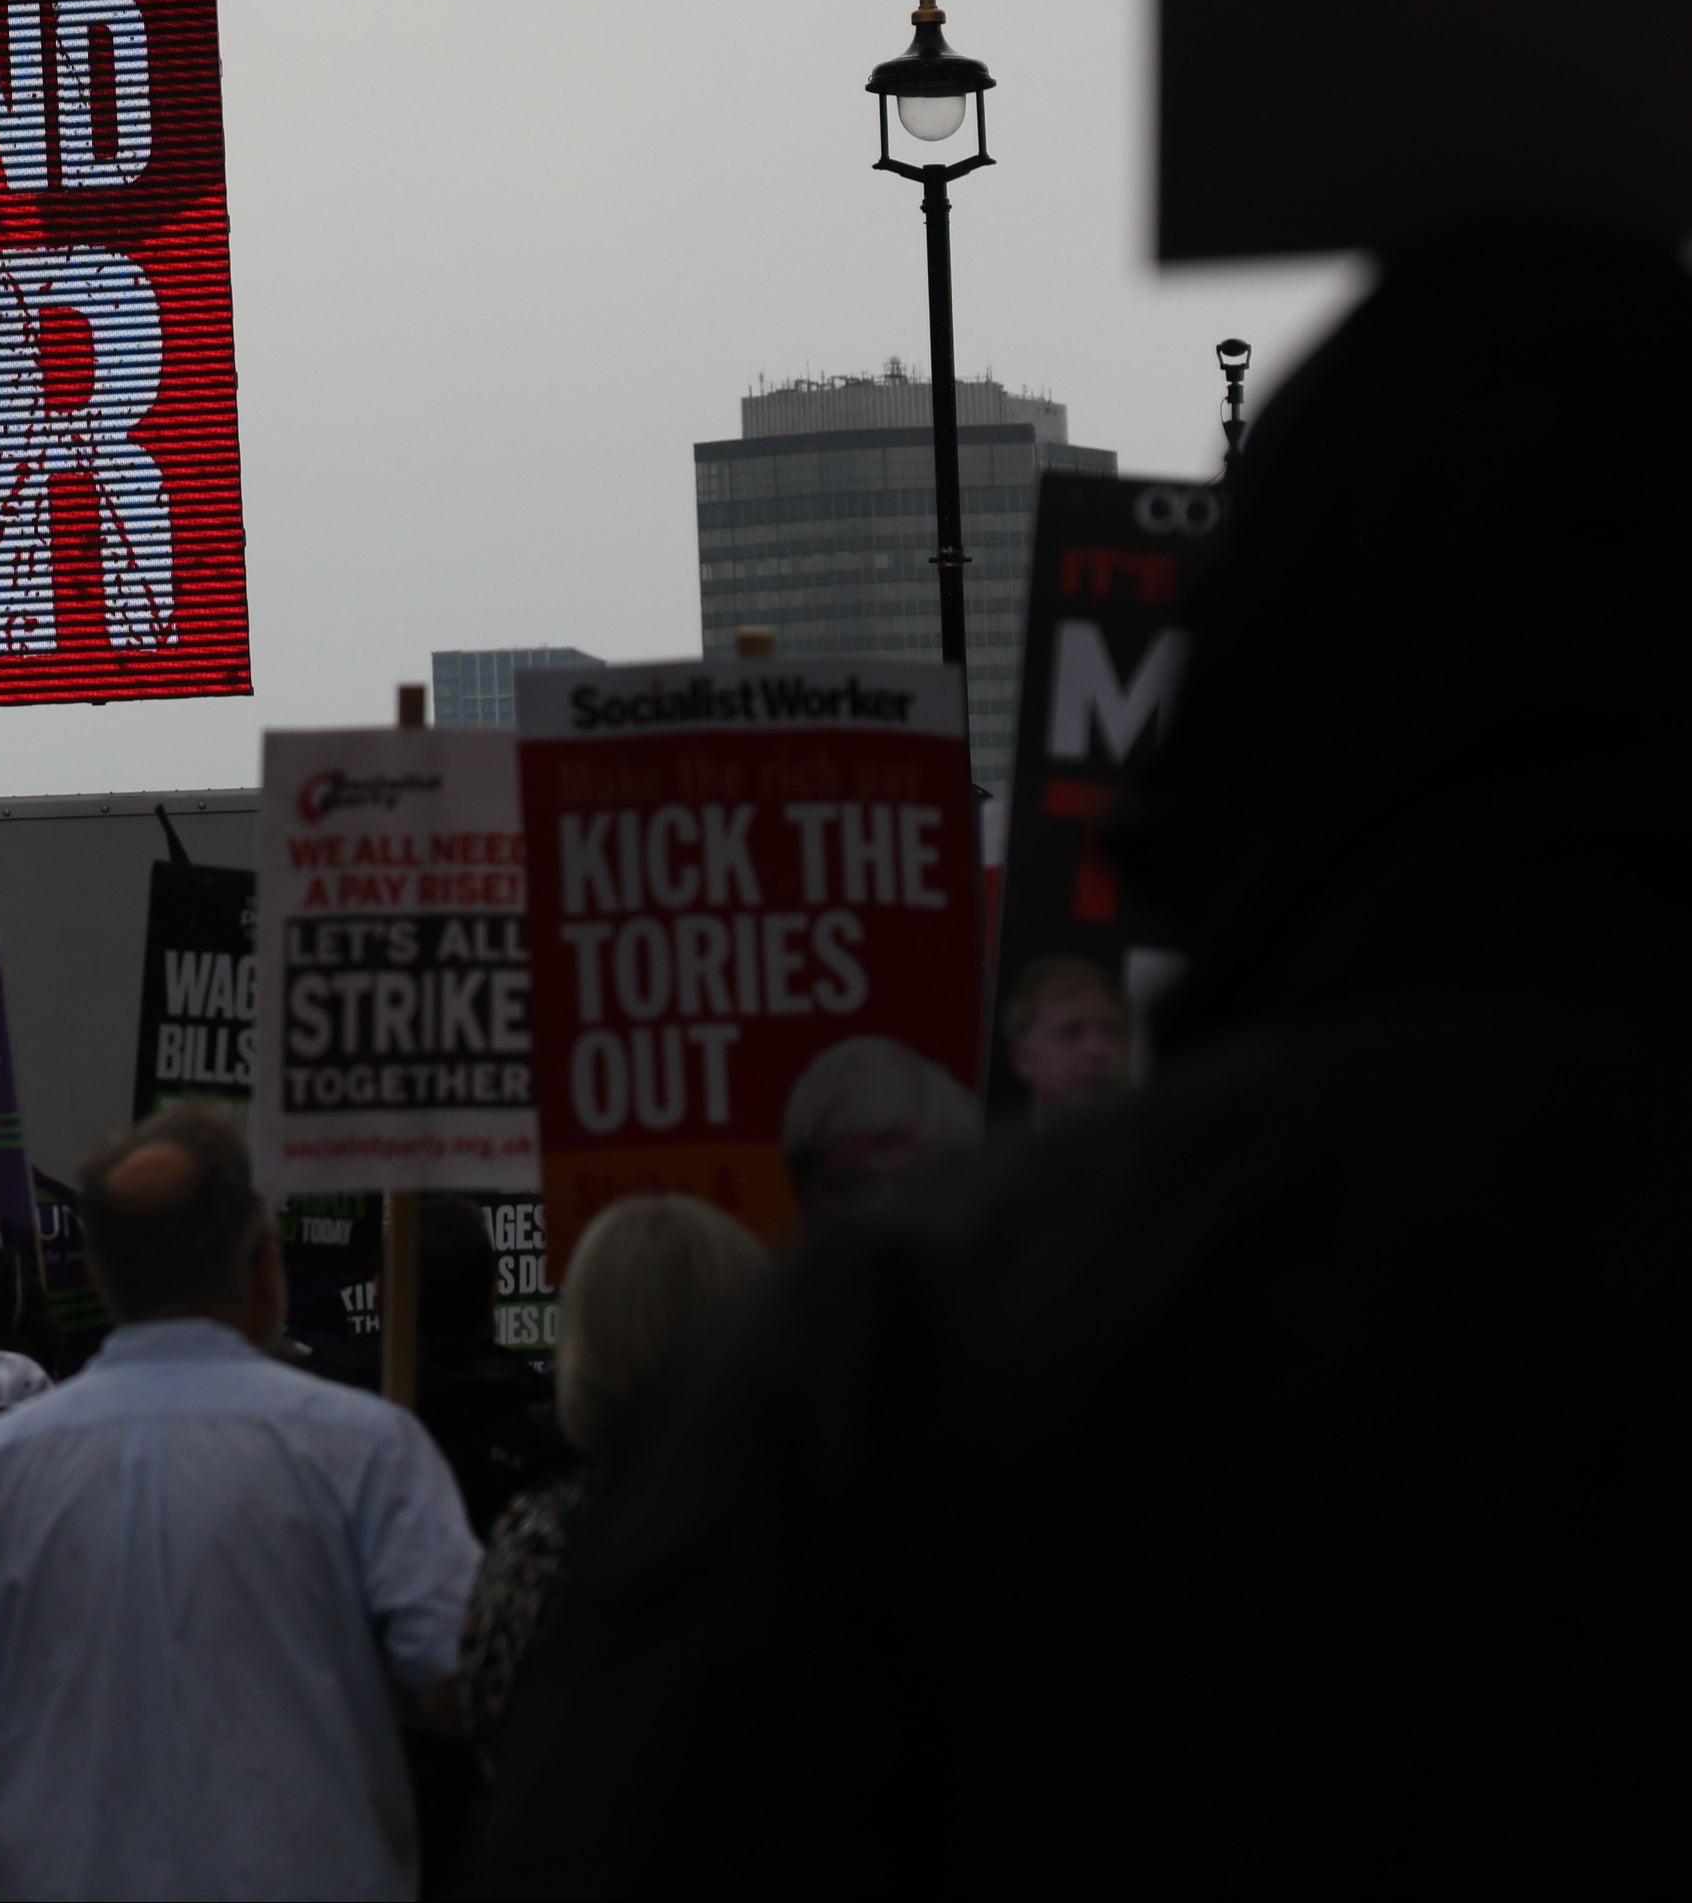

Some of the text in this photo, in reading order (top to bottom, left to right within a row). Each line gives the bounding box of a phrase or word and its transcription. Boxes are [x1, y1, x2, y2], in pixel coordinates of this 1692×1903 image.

[572, 676, 913, 728] Socialist Worker
[287, 833, 344, 870] WE
[352, 833, 423, 867] ALL
[557, 800, 763, 916] KICK
[782, 800, 949, 912] THE
[304, 875, 329, 908] A
[337, 873, 409, 908] PAY
[287, 918, 530, 967] LET'S ALL
[557, 906, 871, 1025] TORIES
[287, 967, 533, 1059] STRIKE
[286, 1062, 533, 1107] TOGETHER
[568, 1020, 743, 1137] OUT
